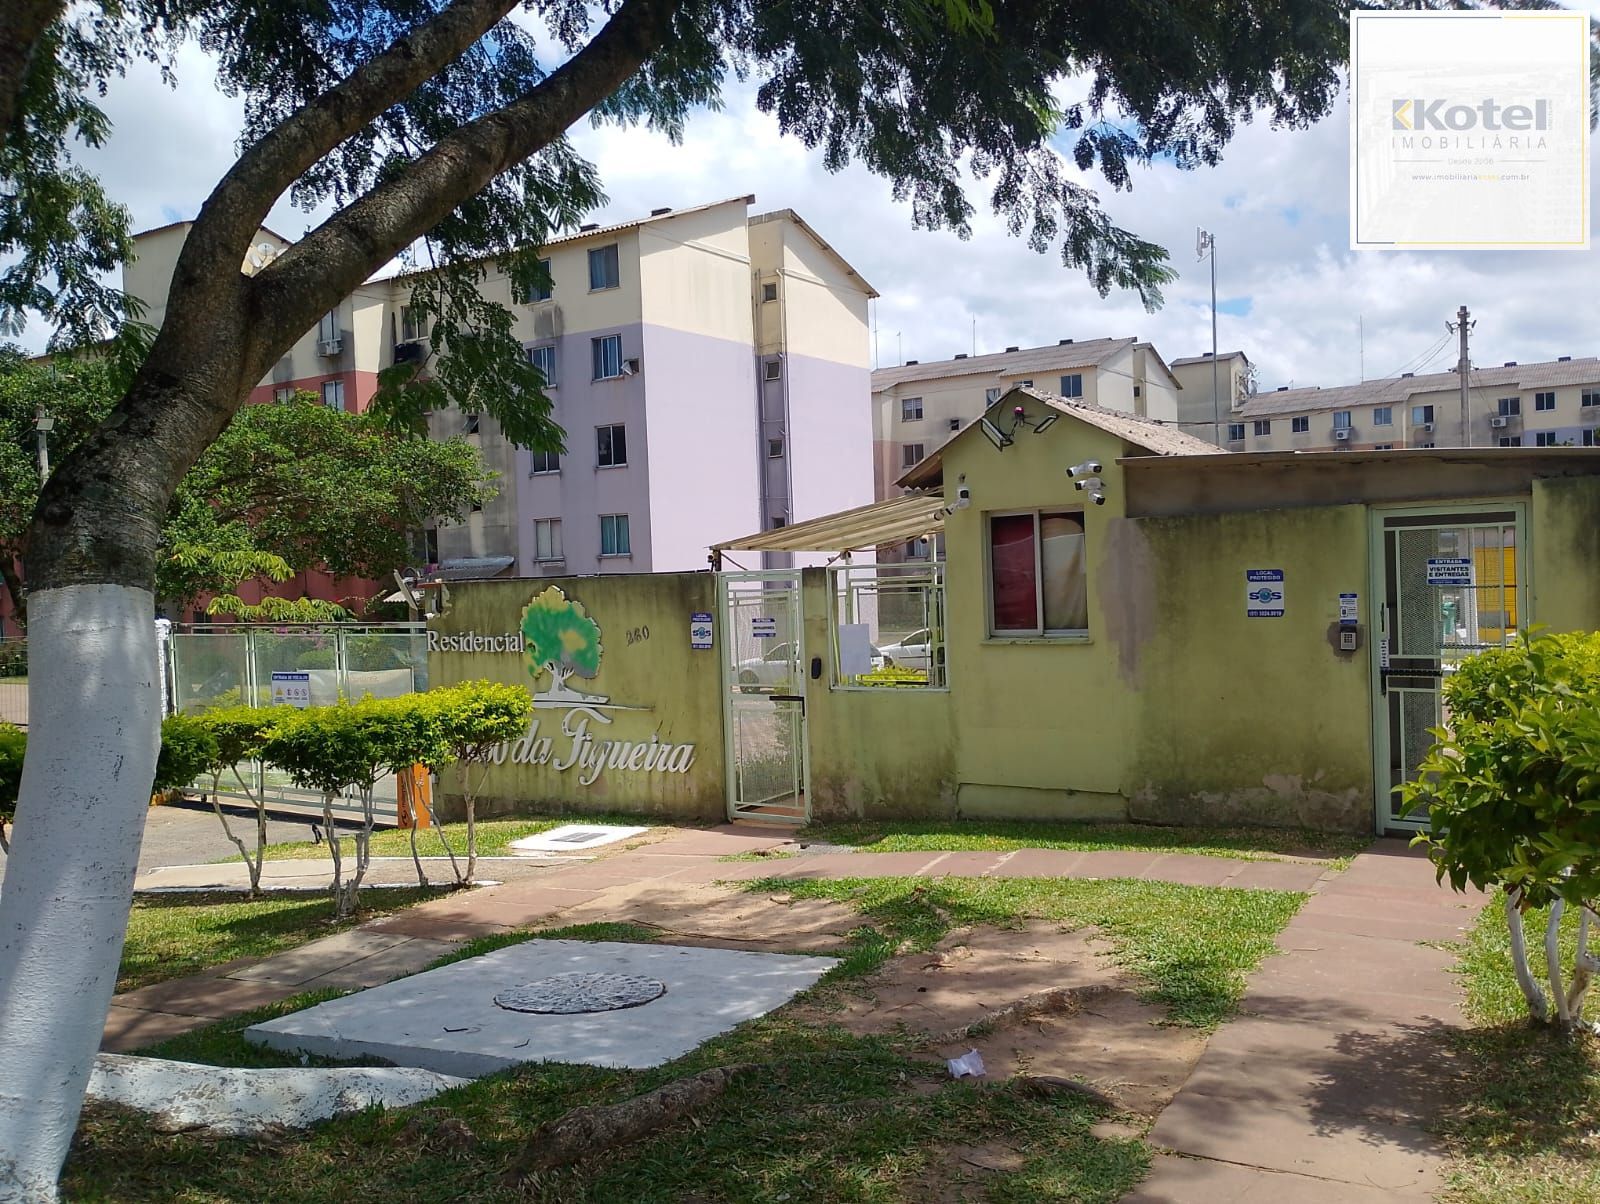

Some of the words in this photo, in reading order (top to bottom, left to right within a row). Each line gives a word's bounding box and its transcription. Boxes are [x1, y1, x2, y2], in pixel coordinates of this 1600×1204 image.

[427, 630, 525, 653] Residencial
[625, 625, 650, 648] 260
[512, 719, 552, 765] da
[553, 708, 696, 785] Figueira
